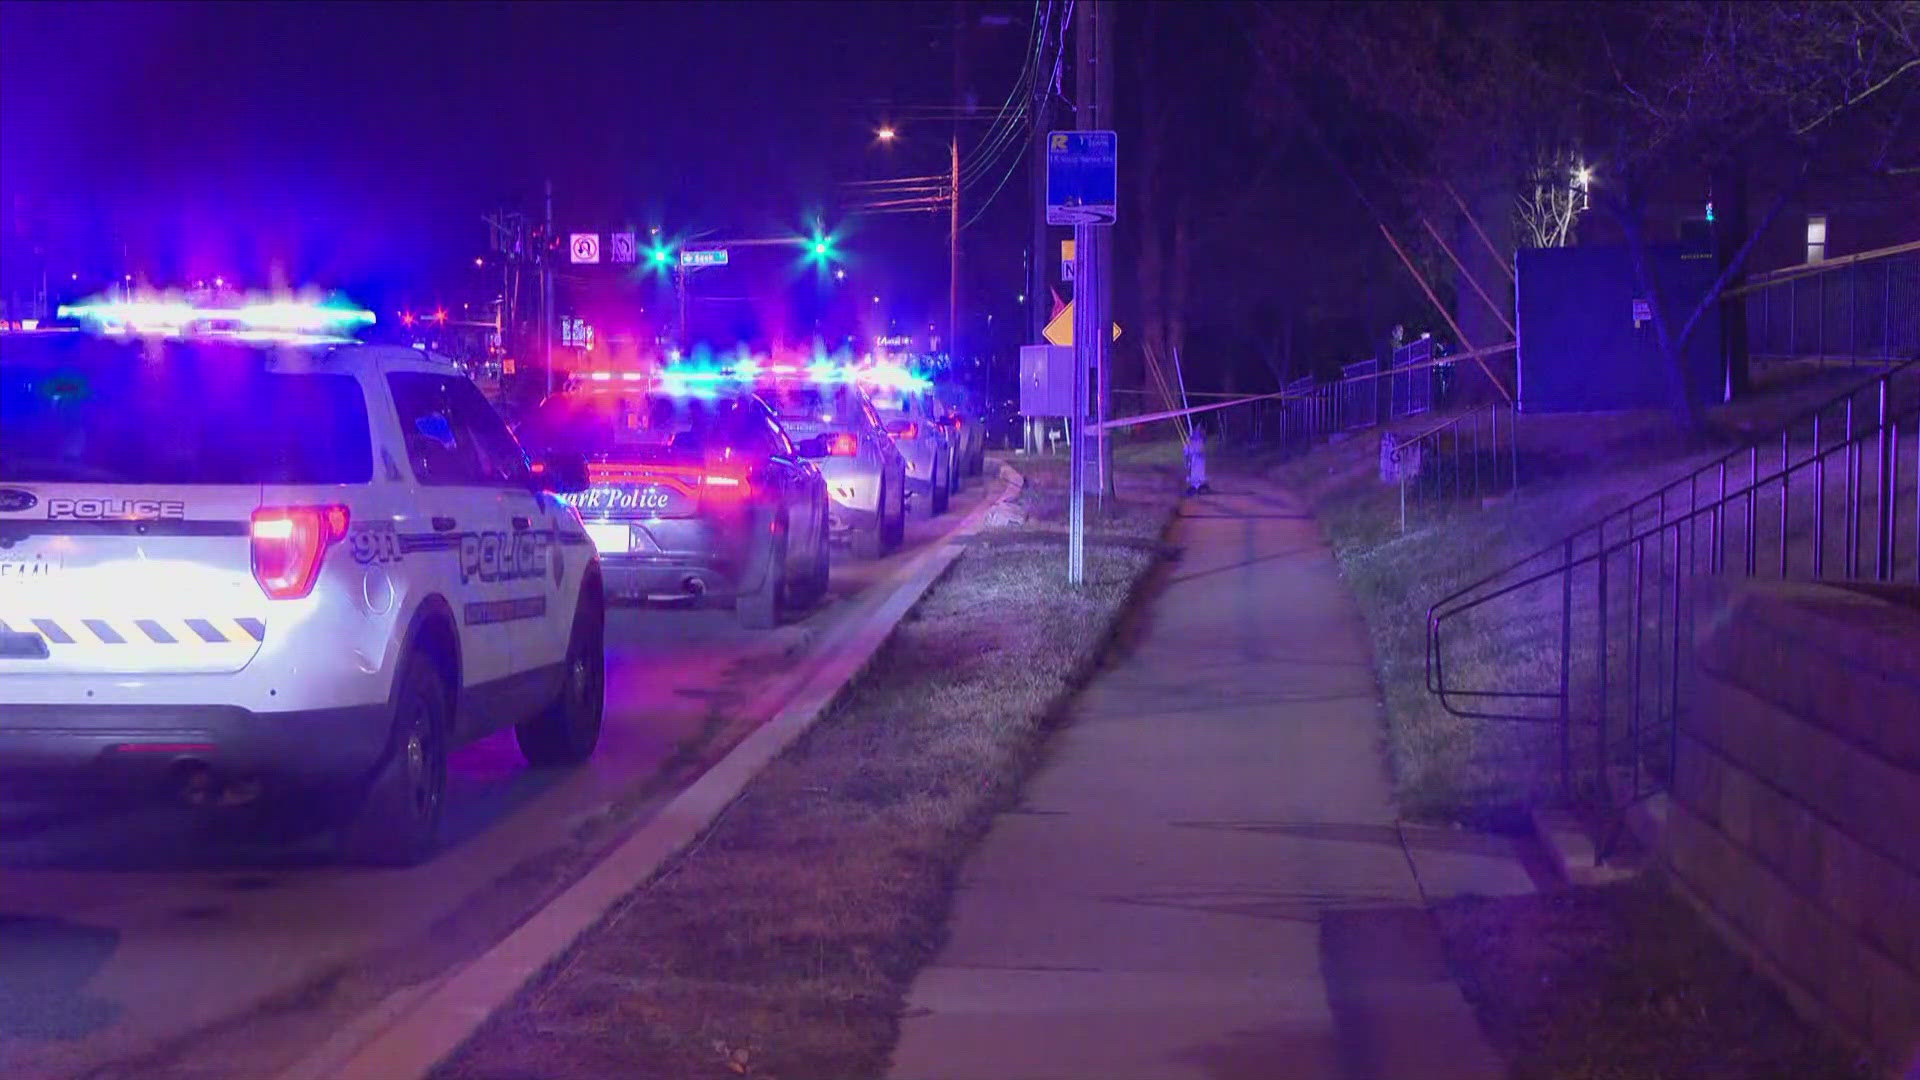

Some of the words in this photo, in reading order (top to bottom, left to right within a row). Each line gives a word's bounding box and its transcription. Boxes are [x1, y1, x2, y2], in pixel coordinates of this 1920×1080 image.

[47, 499, 184, 520] POLICE
[604, 488, 669, 508] Police
[350, 529, 403, 564] 911
[459, 531, 546, 584] POLICE
